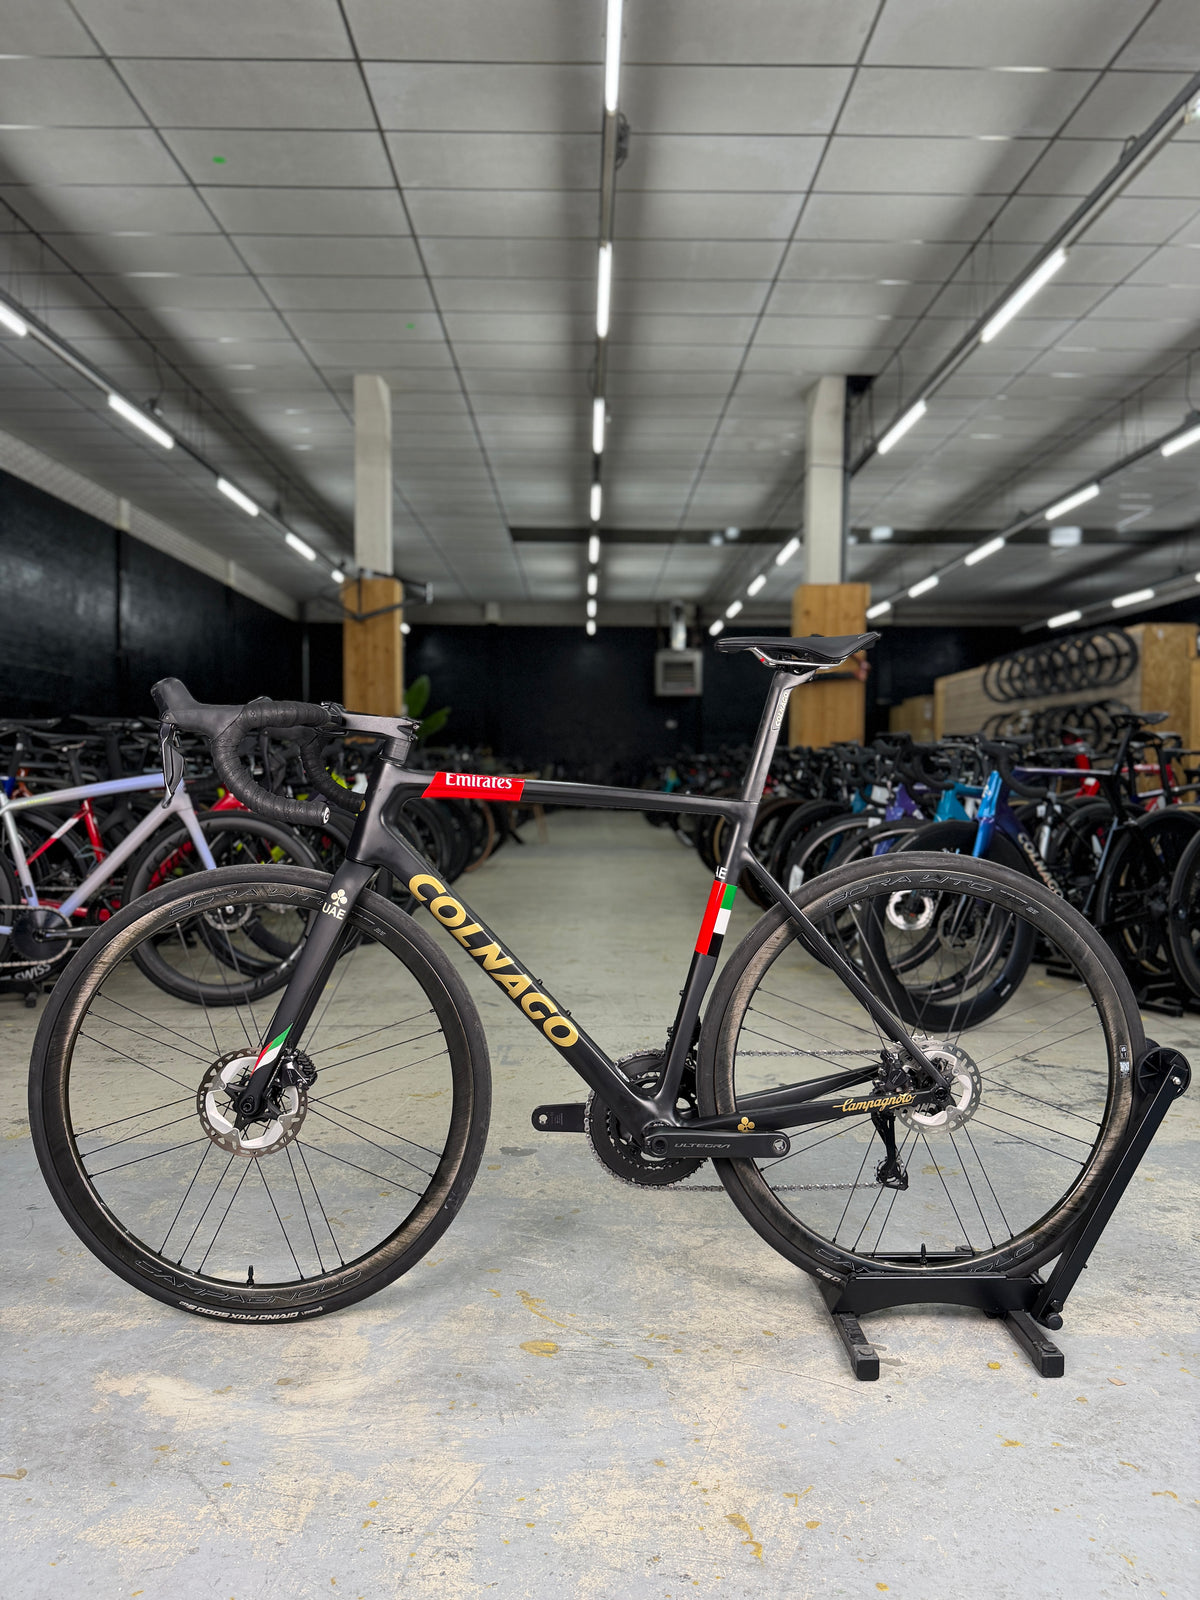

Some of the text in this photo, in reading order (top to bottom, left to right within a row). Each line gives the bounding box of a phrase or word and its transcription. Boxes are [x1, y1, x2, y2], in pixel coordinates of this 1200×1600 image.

[445, 772, 513, 790] Emirates
[322, 902, 347, 920] UAE
[408, 873, 579, 1047] COLNAGO
[14, 963, 51, 981] SWISS
[832, 1089, 917, 1113] Campagnolo
[134, 1258, 362, 1304] CAMPAGNOLO
